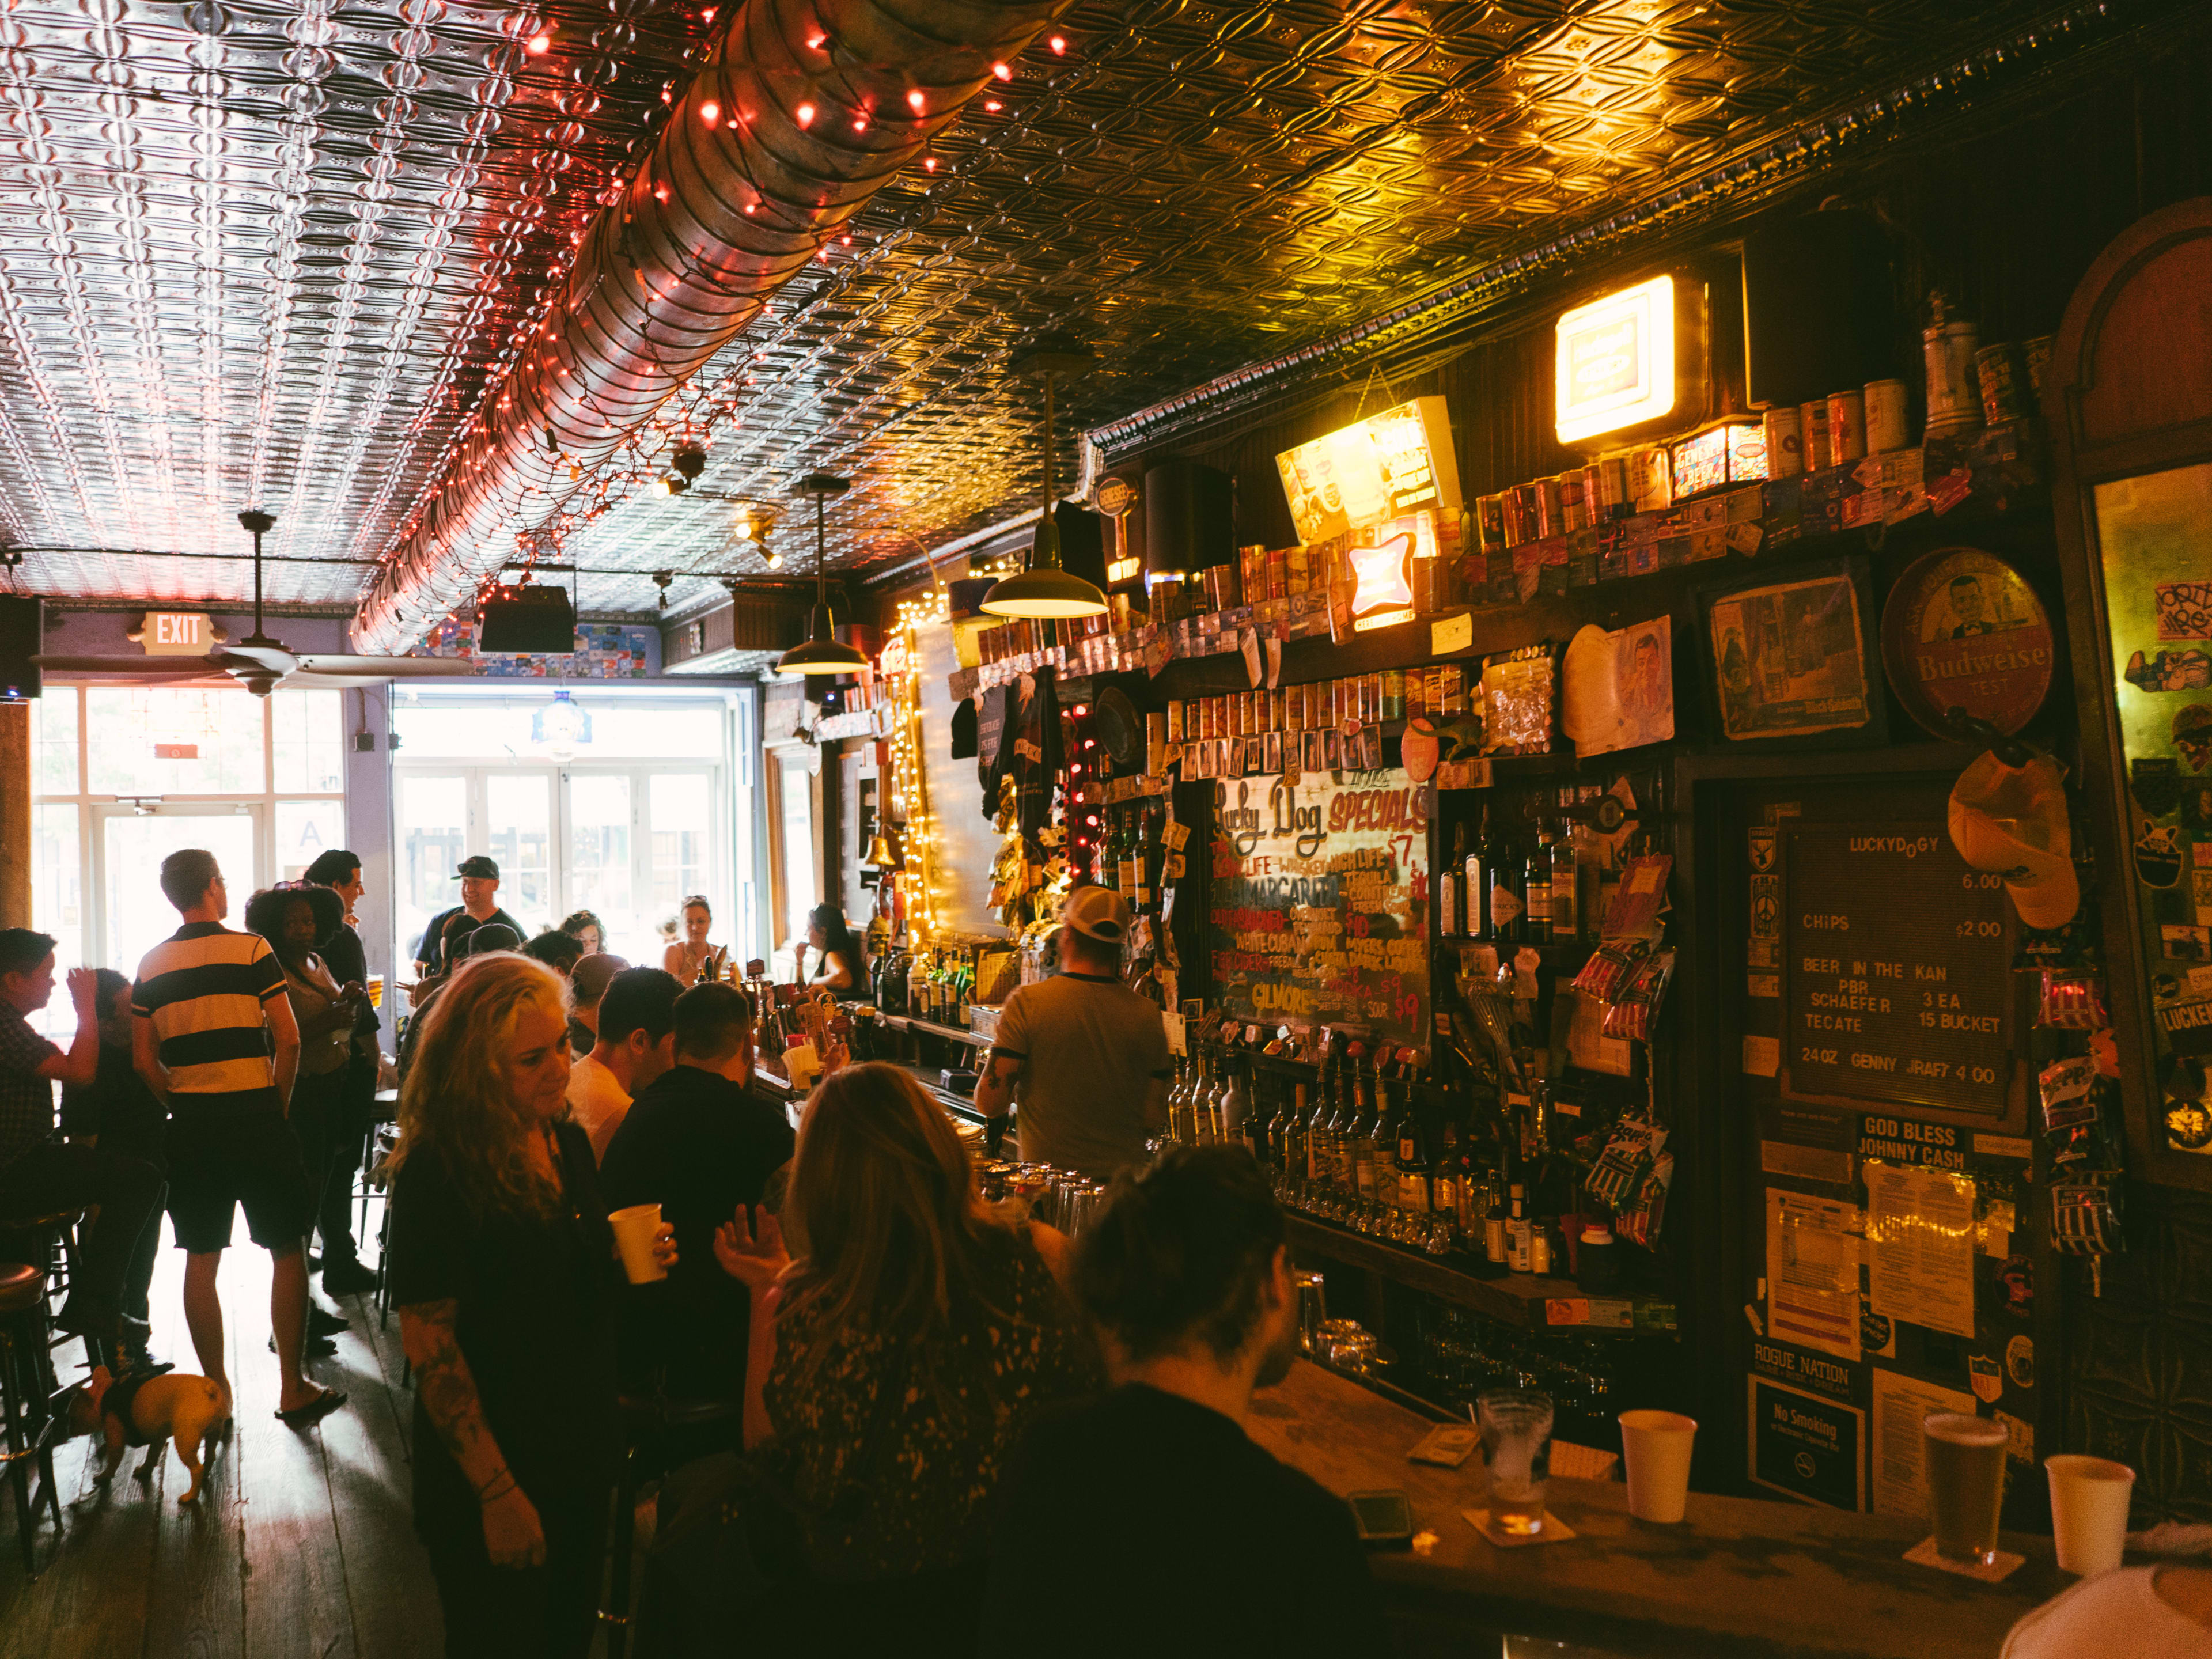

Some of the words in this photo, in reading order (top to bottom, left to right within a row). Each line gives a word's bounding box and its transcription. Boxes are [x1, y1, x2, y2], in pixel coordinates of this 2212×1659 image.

[1686, 462, 1715, 486] BEER
[157, 614, 201, 645] EXIT
[1968, 678, 2009, 696] TEST
[1213, 780, 1267, 858] Lucky
[1269, 775, 1327, 858] Dog
[1327, 785, 1429, 834] SPECIALS
[299, 821, 323, 847] A
[1245, 855, 1272, 878] LIFE
[1355, 846, 1386, 869] LIFE
[1387, 834, 1414, 869] $7
[1850, 836, 1939, 858] LUCKYDOGY
[1343, 869, 1392, 887] TEQUILA
[1963, 874, 2001, 889] 6.00
[1235, 930, 1267, 953] WHITE
[1234, 952, 1263, 972] CIDER
[1803, 957, 1840, 974] BEER
[1853, 961, 1867, 976] IN
[1874, 961, 1903, 979] THE
[1915, 965, 1947, 982] KAN
[1252, 983, 1312, 1015] GILMORE
[1327, 979, 1372, 1000] VODKA
[1838, 979, 1869, 995] PBR
[1923, 991, 1933, 1007] 3
[1805, 1013, 1862, 1033] TECATE
[1919, 1012, 1936, 1028] 15
[1941, 1013, 2001, 1033] BUCKET
[1851, 1052, 1897, 1073] GENNY
[1956, 1065, 1966, 1081] 4
[1972, 1067, 1995, 1084] 00
[1865, 1116, 1899, 1138] GOD
[1903, 1122, 1956, 1147] BLESS
[1858, 1137, 1917, 1163] JOHNNY
[1922, 1145, 1965, 1170] CASH
[1754, 1343, 1795, 1370] ROGUE
[1800, 1356, 1849, 1386] NATION
[1774, 1403, 1788, 1422] No
[1790, 1409, 1837, 1441] Smoking
